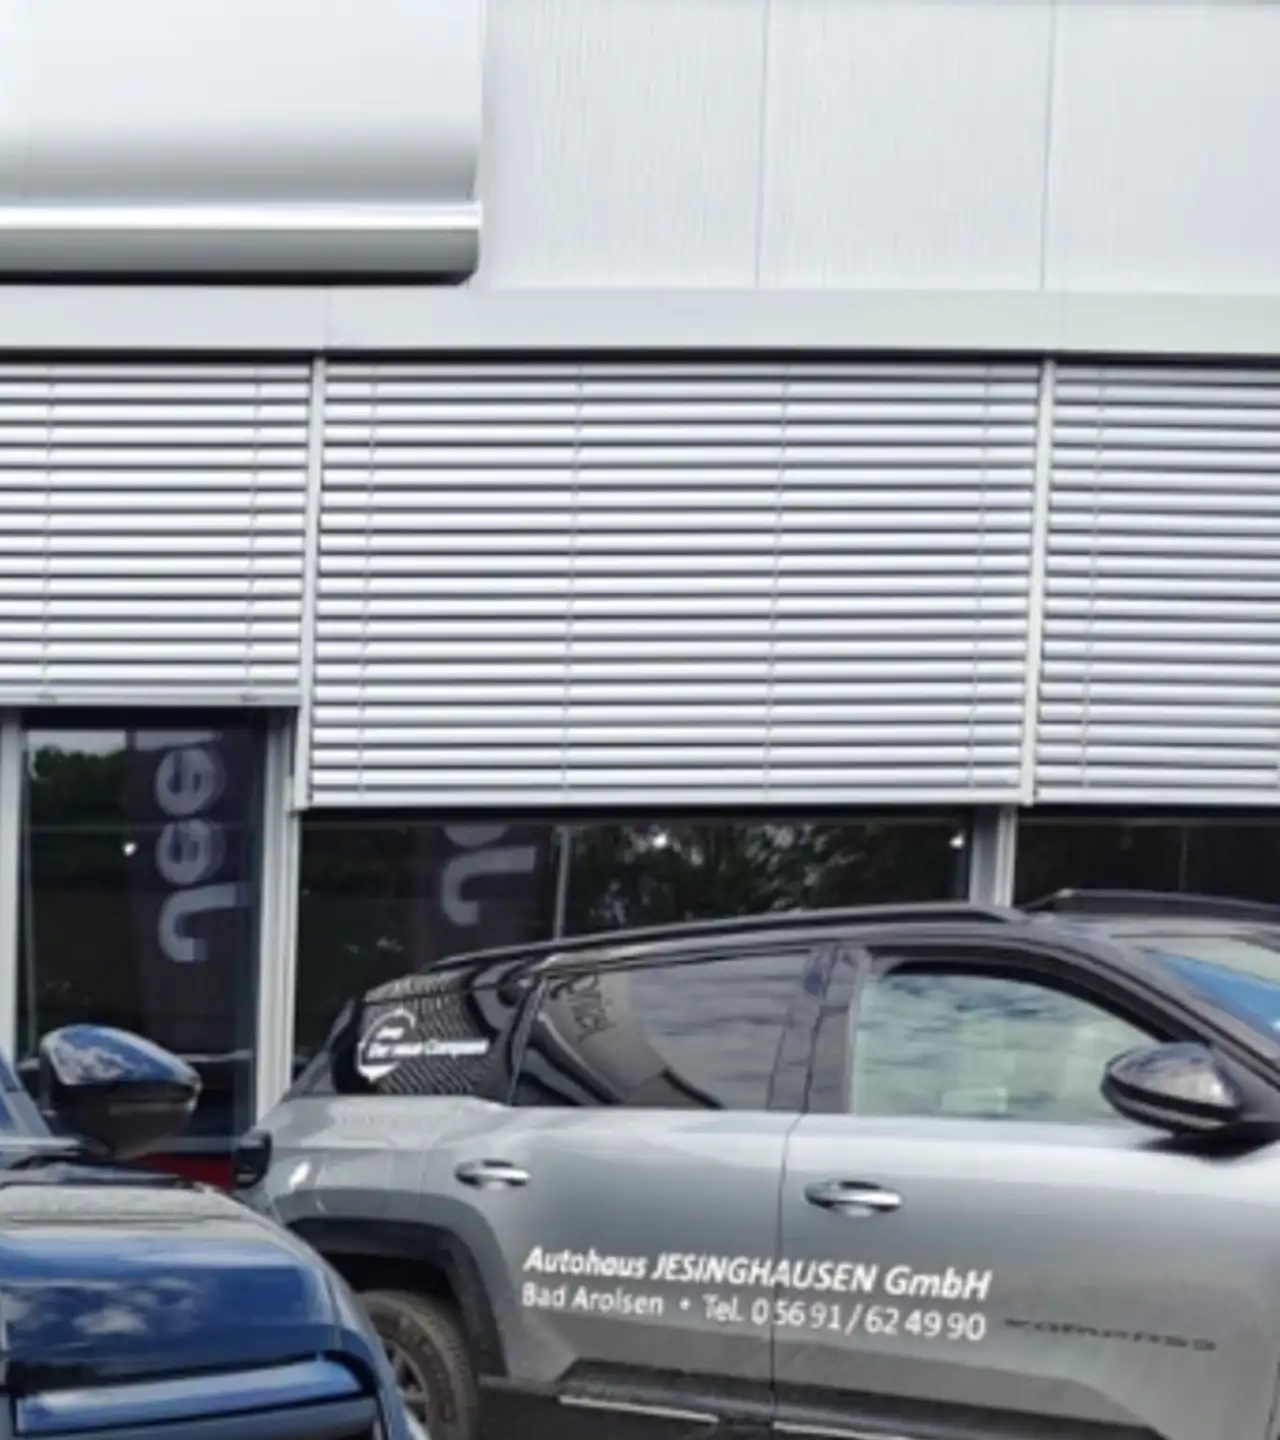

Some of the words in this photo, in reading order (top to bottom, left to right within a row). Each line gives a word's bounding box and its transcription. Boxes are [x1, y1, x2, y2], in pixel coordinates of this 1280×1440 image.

[522, 1245, 648, 1280] Autohaus
[650, 1250, 879, 1294] JESINGHAUSEN
[884, 1265, 993, 1301] GmbH
[522, 1281, 565, 1308] Bad
[571, 1285, 664, 1317] Arolsen
[702, 1292, 745, 1322] Tel.
